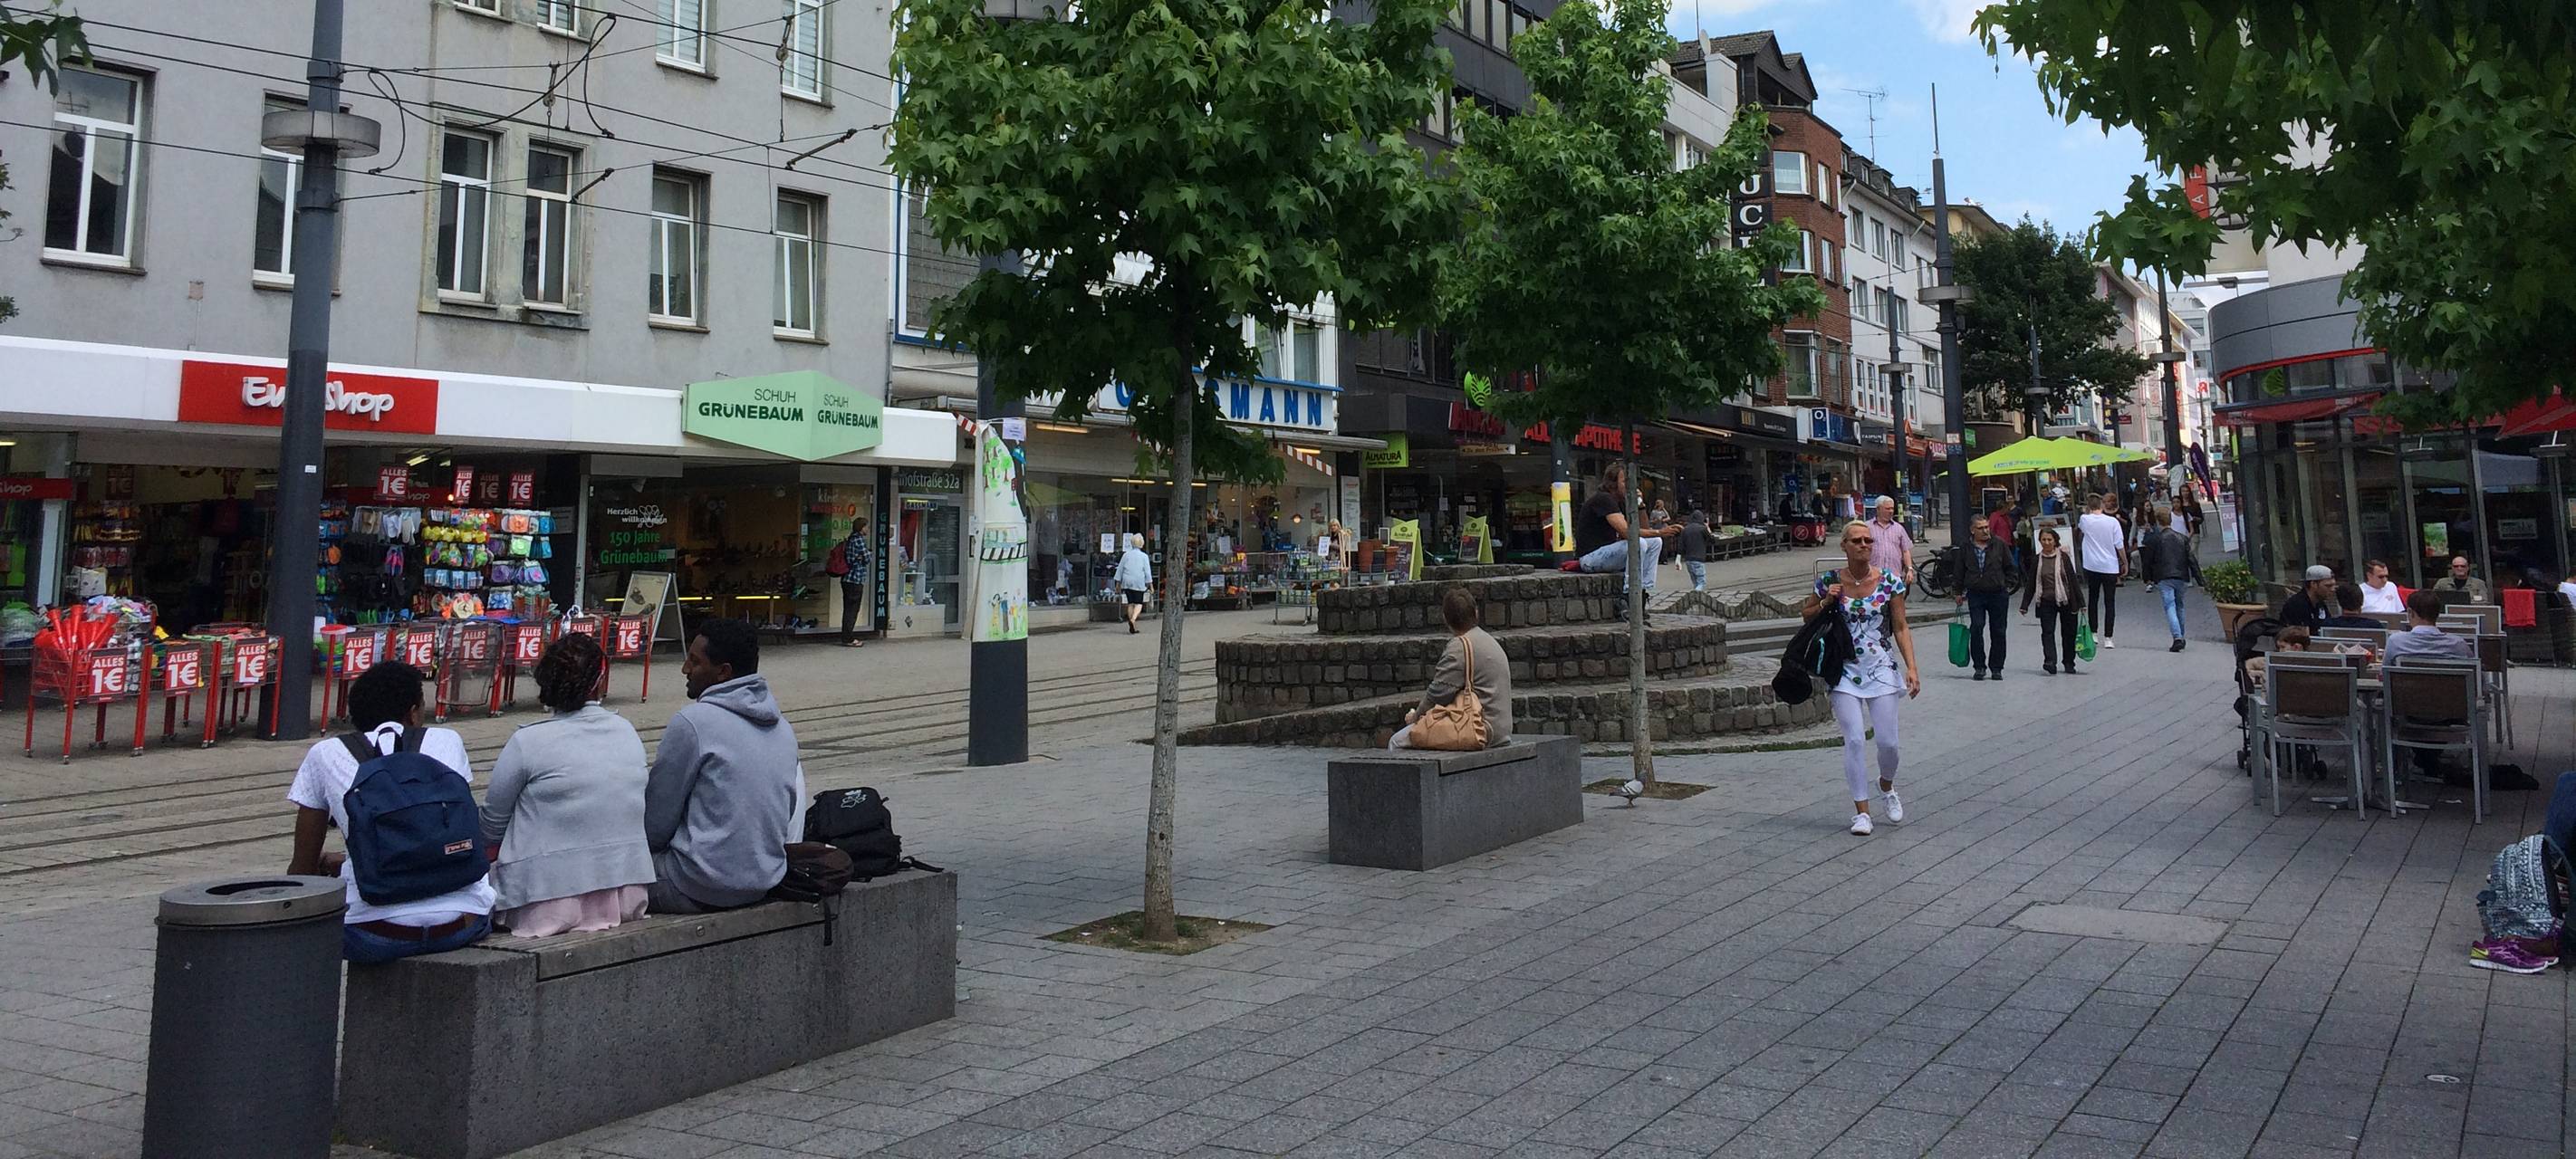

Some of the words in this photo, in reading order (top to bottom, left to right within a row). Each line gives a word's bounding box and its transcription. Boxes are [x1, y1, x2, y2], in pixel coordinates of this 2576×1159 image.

[754, 388, 797, 404] SCHUH
[823, 393, 850, 407] SCHUH
[698, 401, 804, 422] GRÜNEBAUM
[817, 409, 879, 429] GRÜNEBAUM
[1571, 424, 1641, 455] APOTHEE
[1365, 450, 1402, 462] ALNATURA
[381, 468, 408, 477] ALLES
[512, 474, 533, 482] ALLES
[380, 475, 407, 495] 1€
[456, 479, 472, 498] 1€
[944, 473, 960, 489] 32a
[511, 482, 532, 500] 1€
[607, 507, 639, 515] Herzlich
[609, 531, 631, 546] 150
[634, 530, 660, 545] Jahre
[600, 548, 668, 564] Grünebaum
[519, 628, 542, 637] ALLES
[620, 621, 640, 630] ALLES
[346, 637, 373, 648] ALLES
[409, 634, 433, 644] ALLES
[619, 630, 640, 650] 1€
[237, 645, 266, 656] ALLES
[408, 643, 432, 666] 1€
[518, 637, 541, 658] 1€
[92, 656, 124, 669] ALLES
[168, 651, 198, 664] ALLES
[345, 647, 372, 672] 1€
[168, 662, 198, 688] 1€
[237, 655, 265, 683] 1€
[92, 667, 124, 694] 1€
